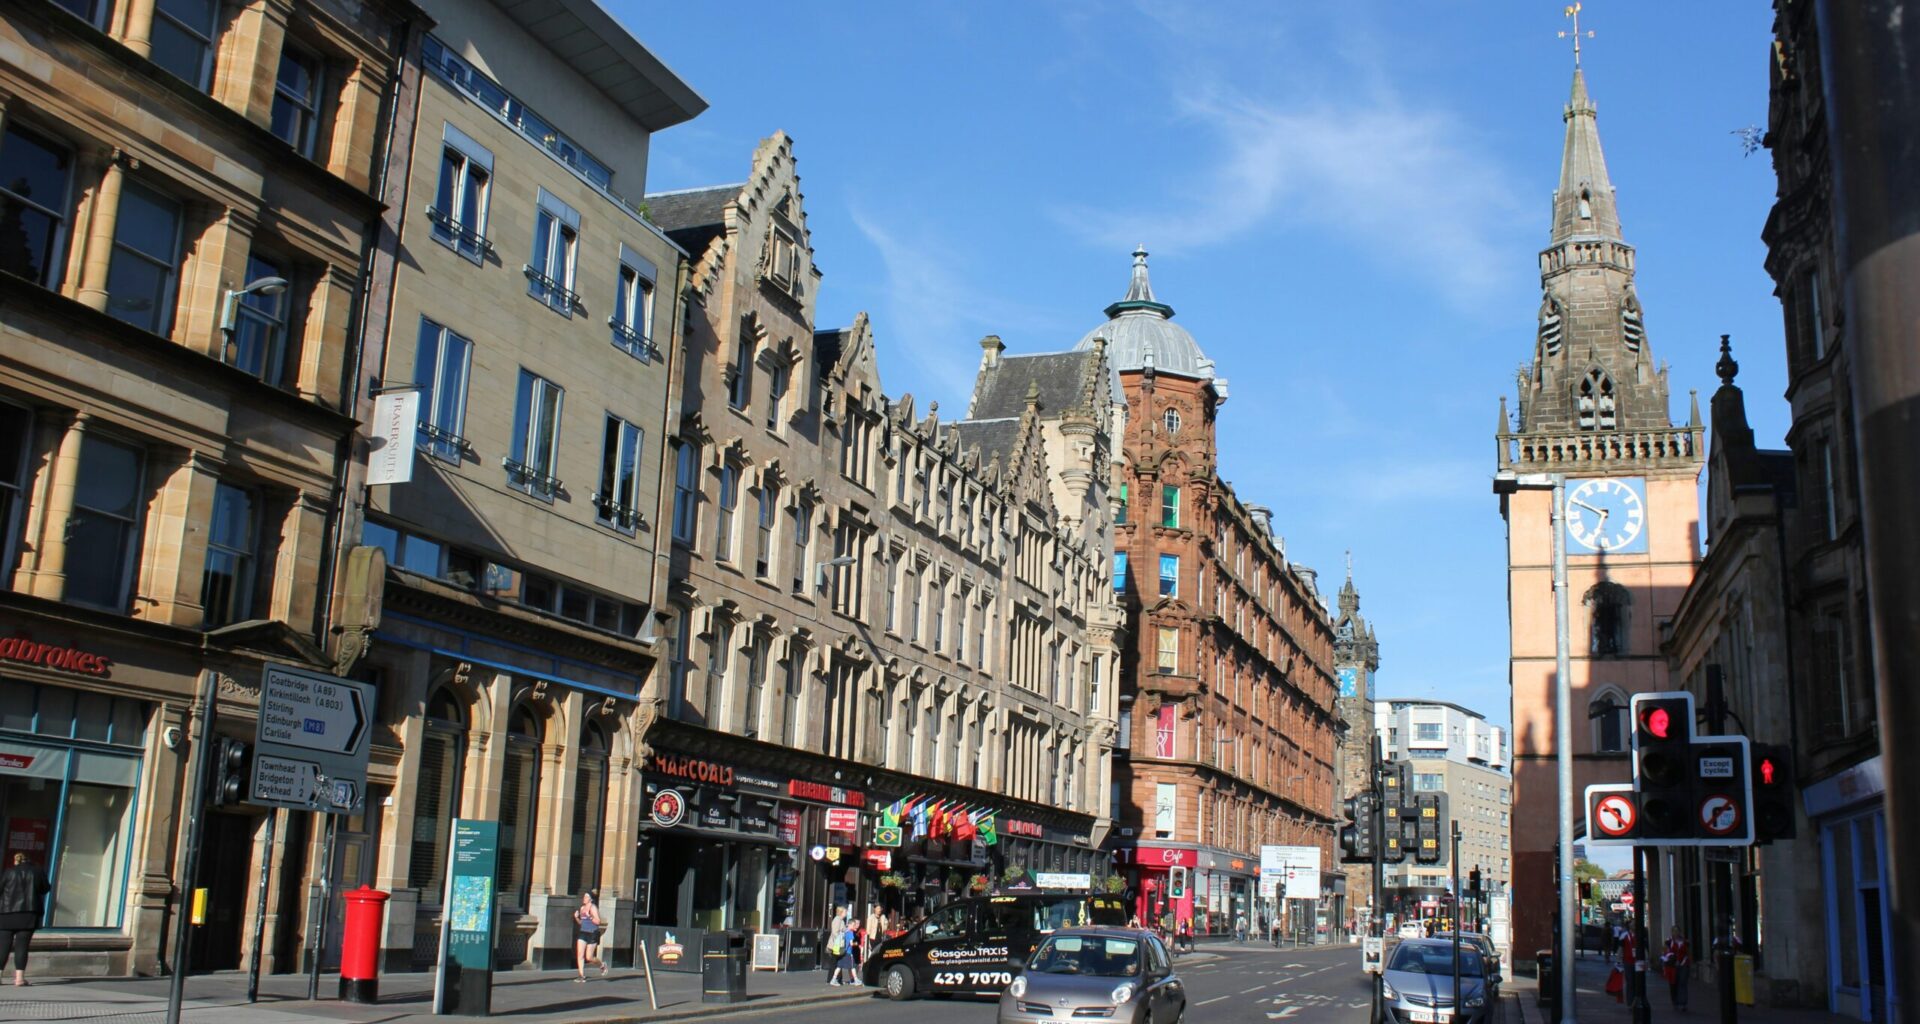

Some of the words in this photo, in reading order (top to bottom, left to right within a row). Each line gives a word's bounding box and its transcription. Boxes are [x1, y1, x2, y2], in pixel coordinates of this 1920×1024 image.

[270, 675, 309, 692] Coatbridge
[269, 688, 311, 704] Kirkintilloch
[267, 701, 294, 715] Stirling
[266, 714, 302, 729] Edinburgh
[264, 727, 292, 739] Carlisle
[260, 761, 296, 773] Townhead
[1703, 760, 1729, 768] Except
[1704, 767, 1729, 775] cycles
[259, 772, 294, 785] Bridgeton
[258, 784, 291, 796] Parkhead
[1162, 849, 1184, 864] Cafe
[930, 948, 977, 959] Glasgow
[977, 946, 1009, 956] TAXIS
[934, 972, 964, 985] 429
[968, 972, 1012, 985] 7070
